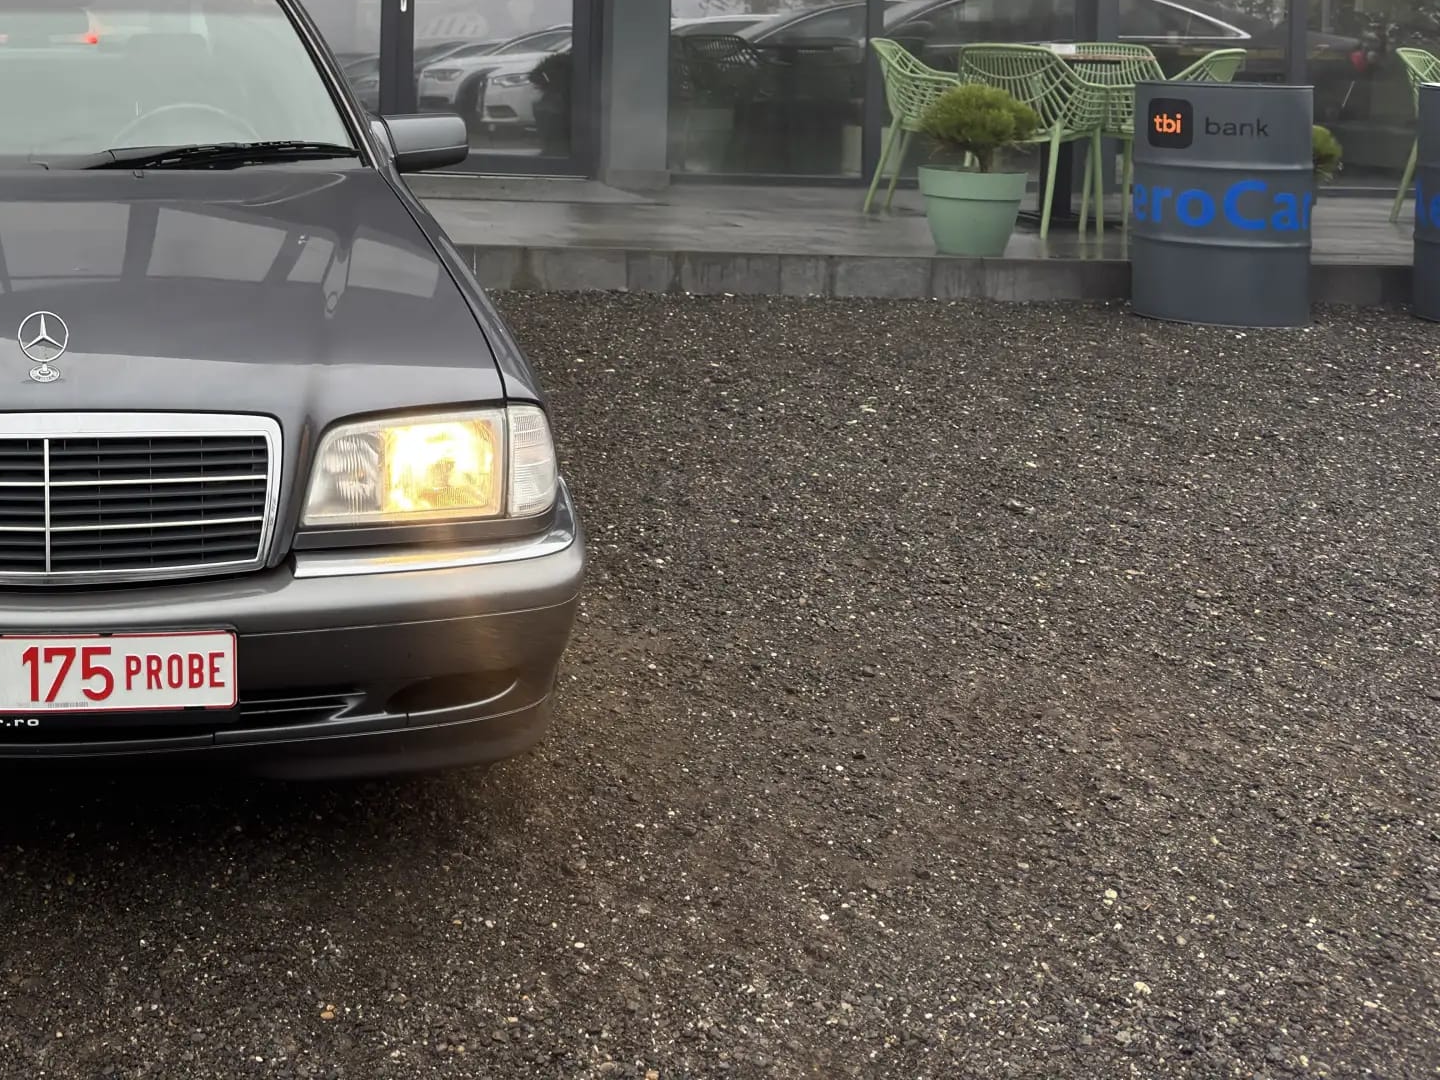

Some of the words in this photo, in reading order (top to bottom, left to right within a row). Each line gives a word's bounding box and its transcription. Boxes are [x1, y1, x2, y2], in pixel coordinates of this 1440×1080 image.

[1154, 113, 1182, 134] tbi
[1205, 117, 1269, 137] bank
[22, 646, 115, 703] 175
[125, 652, 225, 691] PROBE
